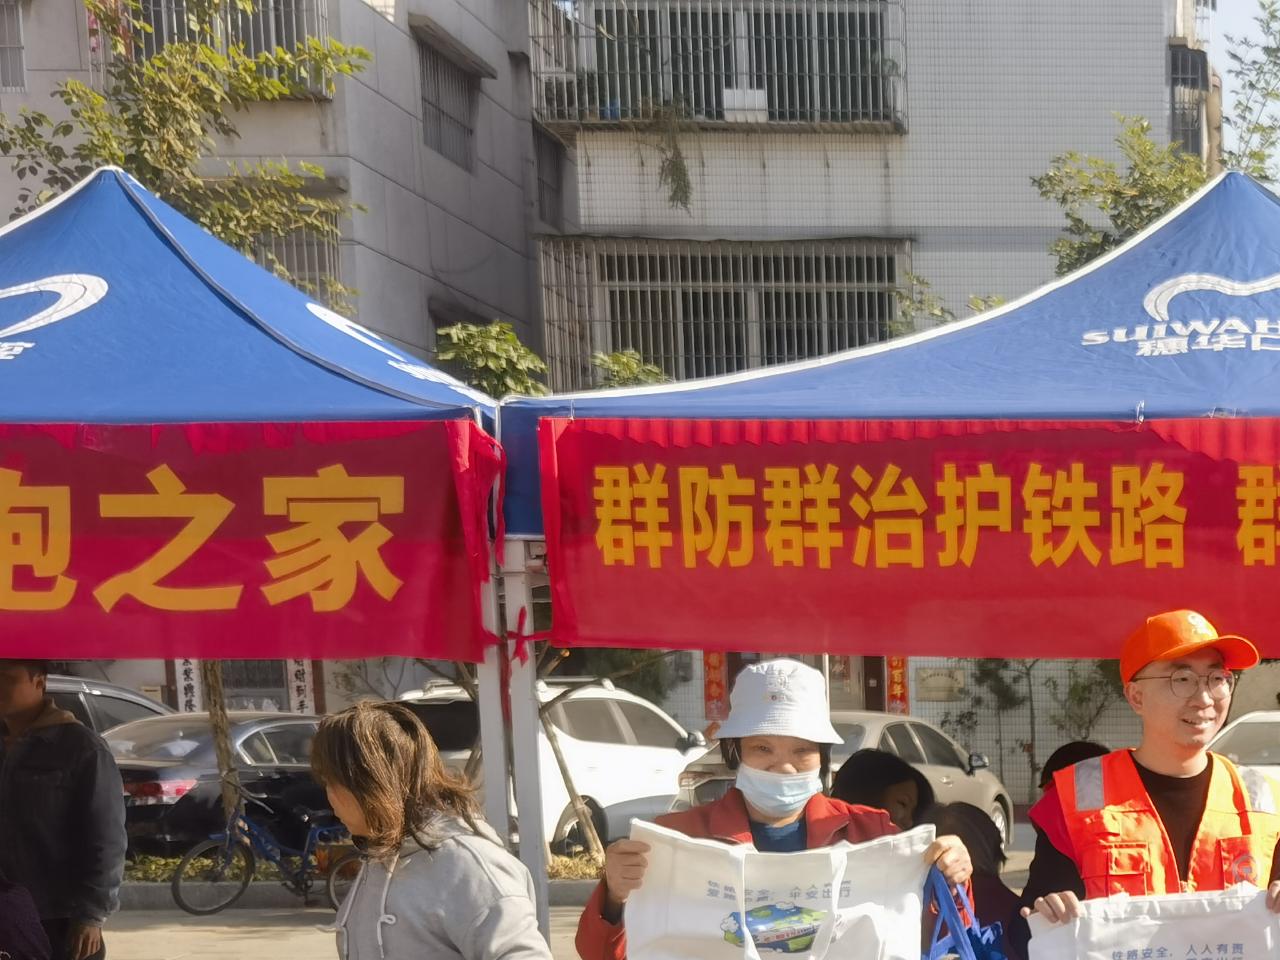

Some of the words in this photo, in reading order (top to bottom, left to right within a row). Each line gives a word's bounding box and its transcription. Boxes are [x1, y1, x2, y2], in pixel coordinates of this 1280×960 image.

[592, 462, 1188, 568] 群防群治护铁路
